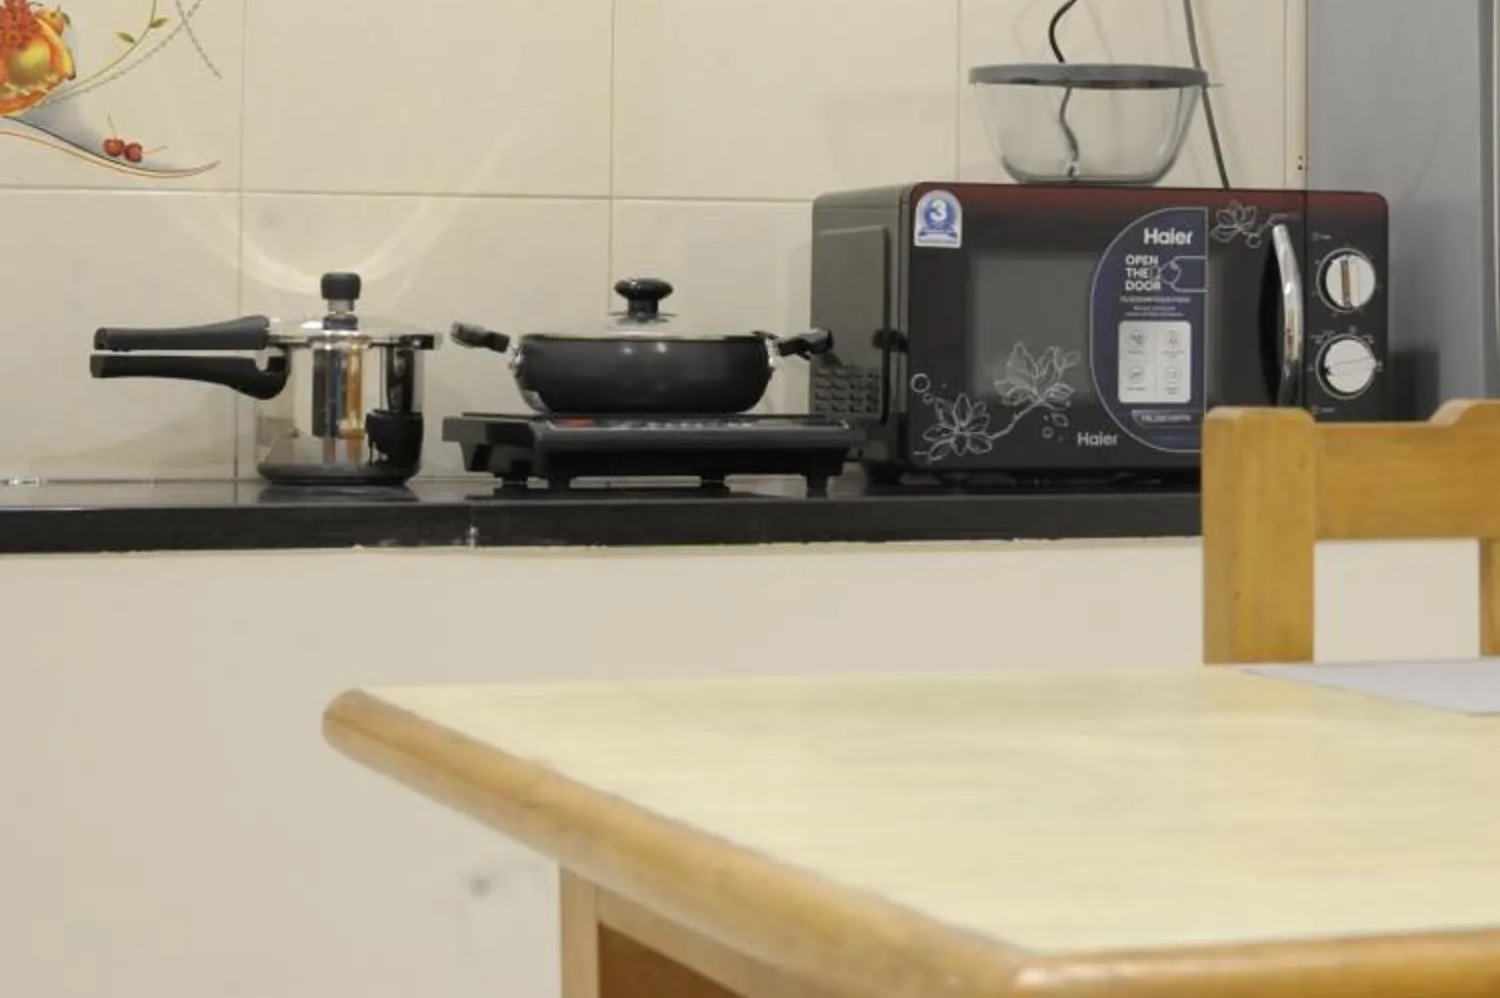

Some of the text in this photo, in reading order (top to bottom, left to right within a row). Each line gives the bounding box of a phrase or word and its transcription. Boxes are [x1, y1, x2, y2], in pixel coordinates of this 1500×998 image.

[1143, 228, 1193, 245] Haier
[1125, 254, 1159, 266] OPEN
[1125, 267, 1149, 279] THE
[1125, 280, 1161, 291] DOOR
[1077, 432, 1118, 446] Haier
